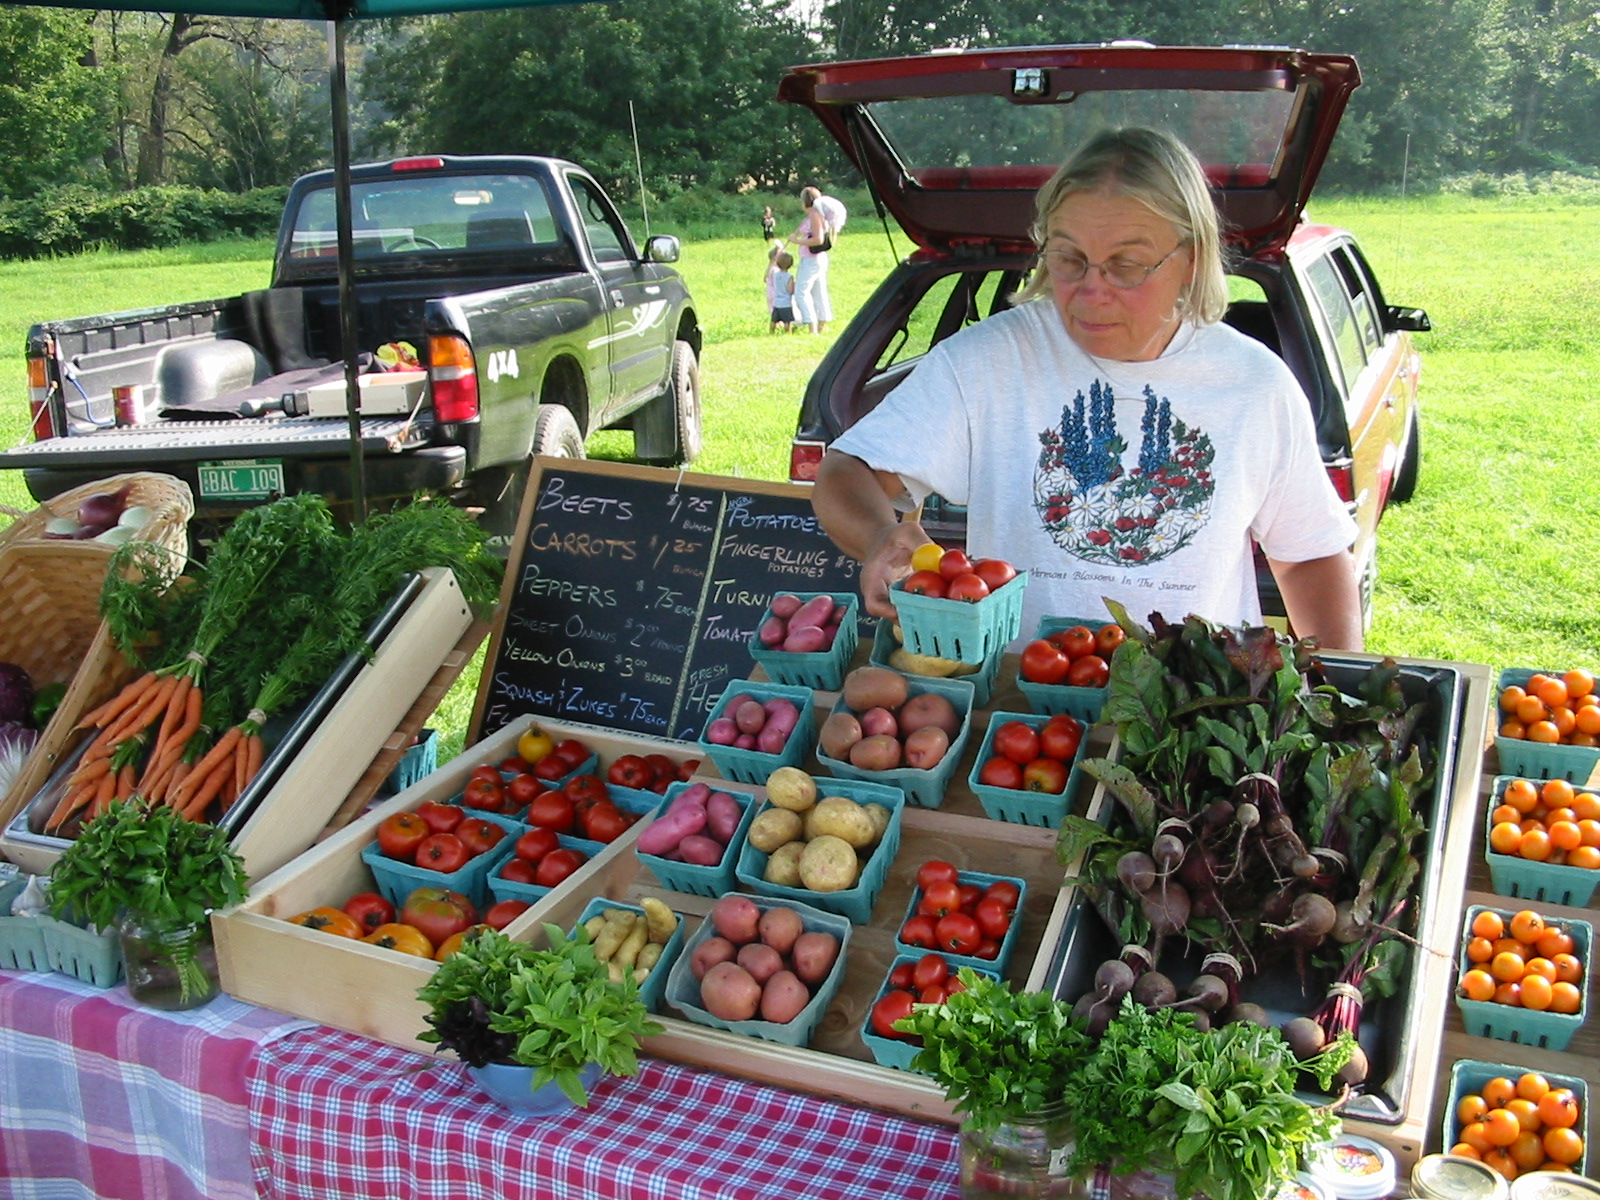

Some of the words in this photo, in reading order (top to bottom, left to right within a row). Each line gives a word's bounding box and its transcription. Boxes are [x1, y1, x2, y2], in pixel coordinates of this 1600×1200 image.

[208, 470, 240, 492] BAC
[250, 468, 279, 490] 109
[537, 477, 633, 521] BEETS
[530, 523, 637, 560] CARROTS
[719, 533, 829, 566] FINGERLING
[519, 563, 617, 609] PEPPERS
[767, 561, 825, 578] POTATOES
[1030, 567, 1067, 580] Vermont
[1072, 570, 1116, 582] Blossoms
[1121, 575, 1132, 586] In
[1137, 578, 1154, 588] The
[1158, 581, 1197, 591] Summer
[713, 578, 772, 607] TURNI
[510, 607, 560, 633] SWEET
[565, 614, 618, 643] ONIONS
[702, 614, 756, 643] TOMAT
[505, 637, 553, 665] YELLOW
[556, 647, 606, 673] ONIONS
[690, 663, 729, 685] FRESH
[495, 671, 554, 707] SQUASH
[566, 686, 618, 718] ZUKES
